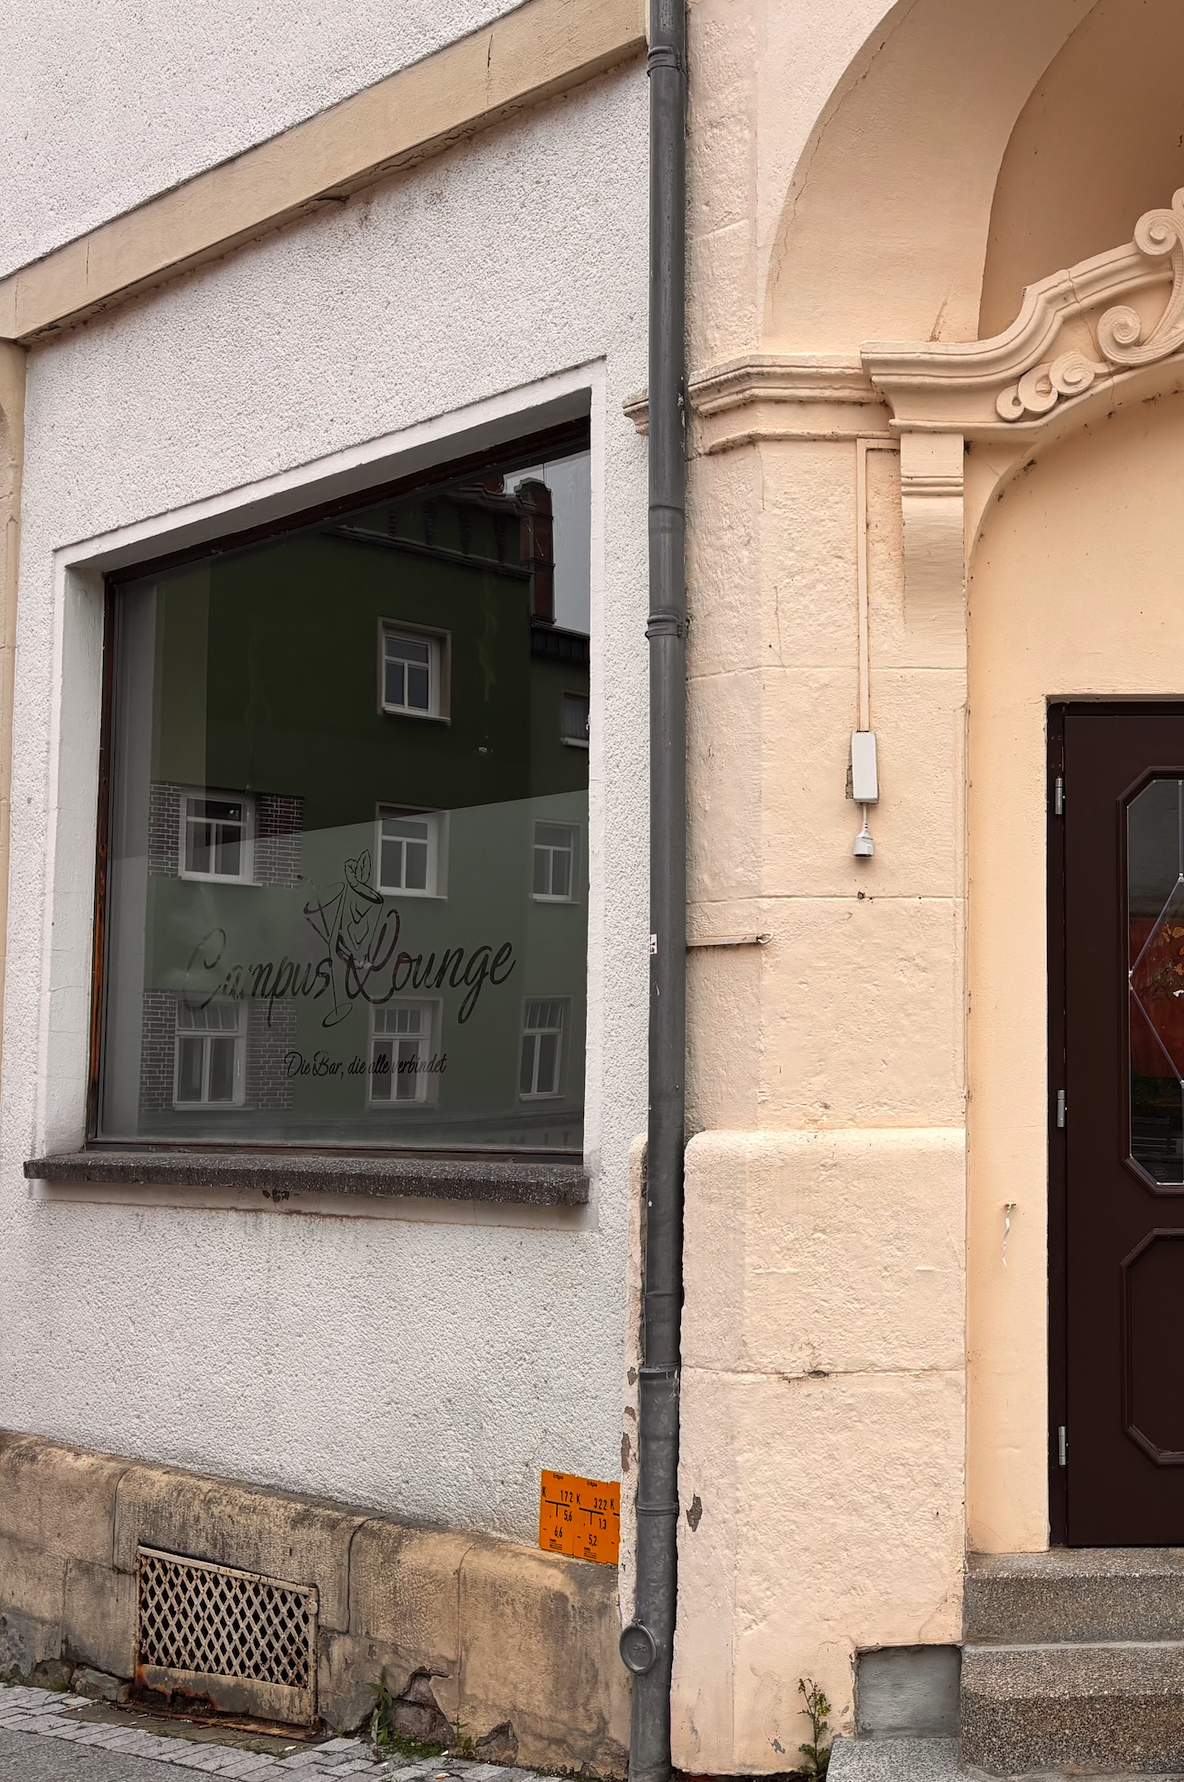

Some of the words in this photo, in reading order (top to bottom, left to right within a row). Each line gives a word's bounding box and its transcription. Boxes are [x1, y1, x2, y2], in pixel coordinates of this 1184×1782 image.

[183, 928, 332, 1027] Campus
[345, 909, 516, 1024] Lounge
[284, 1051, 310, 1077] Die
[313, 1051, 343, 1079] Bar,
[348, 1056, 366, 1075] die
[368, 1054, 390, 1074] alle
[391, 1054, 447, 1074] verbindet
[542, 1486, 547, 1498] K
[561, 1490, 573, 1502] 172
[576, 1494, 581, 1505] K
[594, 1498, 607, 1511] 322
[610, 1498, 615, 1510] K
